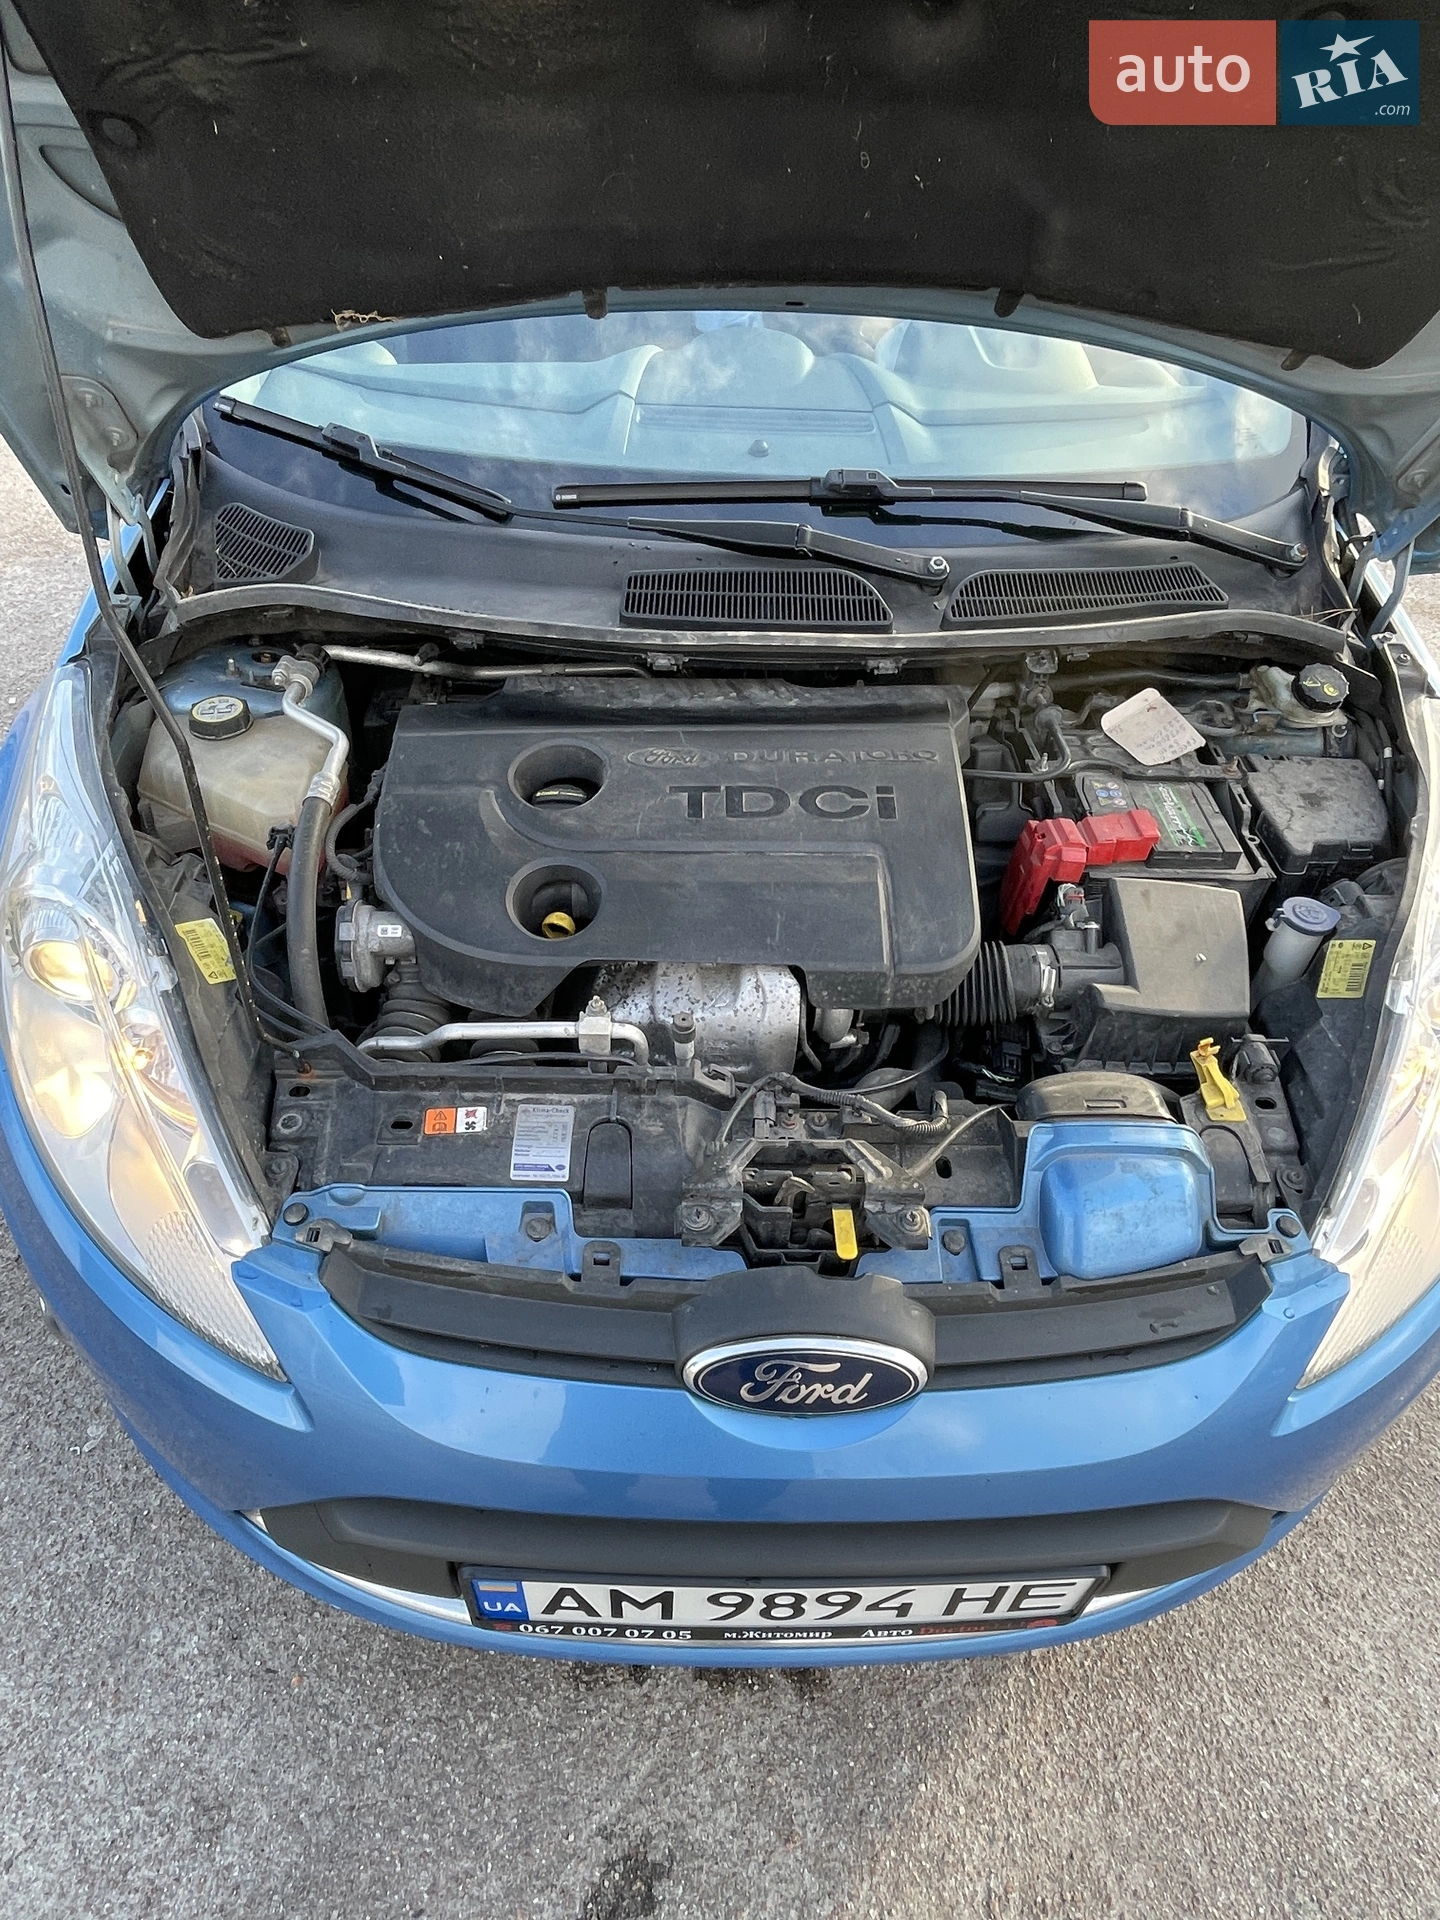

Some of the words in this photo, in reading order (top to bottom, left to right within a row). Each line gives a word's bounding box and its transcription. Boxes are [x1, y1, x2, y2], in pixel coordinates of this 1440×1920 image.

[644, 748, 701, 767] Ford
[668, 784, 897, 820] TDCi
[739, 1359, 874, 1405] Ford
[483, 1601, 523, 1613] UA
[541, 1587, 675, 1621] AM
[706, 1588, 917, 1621] 9894
[941, 1581, 1078, 1617] HE
[519, 1623, 565, 1634] 067
[572, 1626, 617, 1637] 007
[624, 1629, 655, 1639] 07
[662, 1630, 692, 1640] 05
